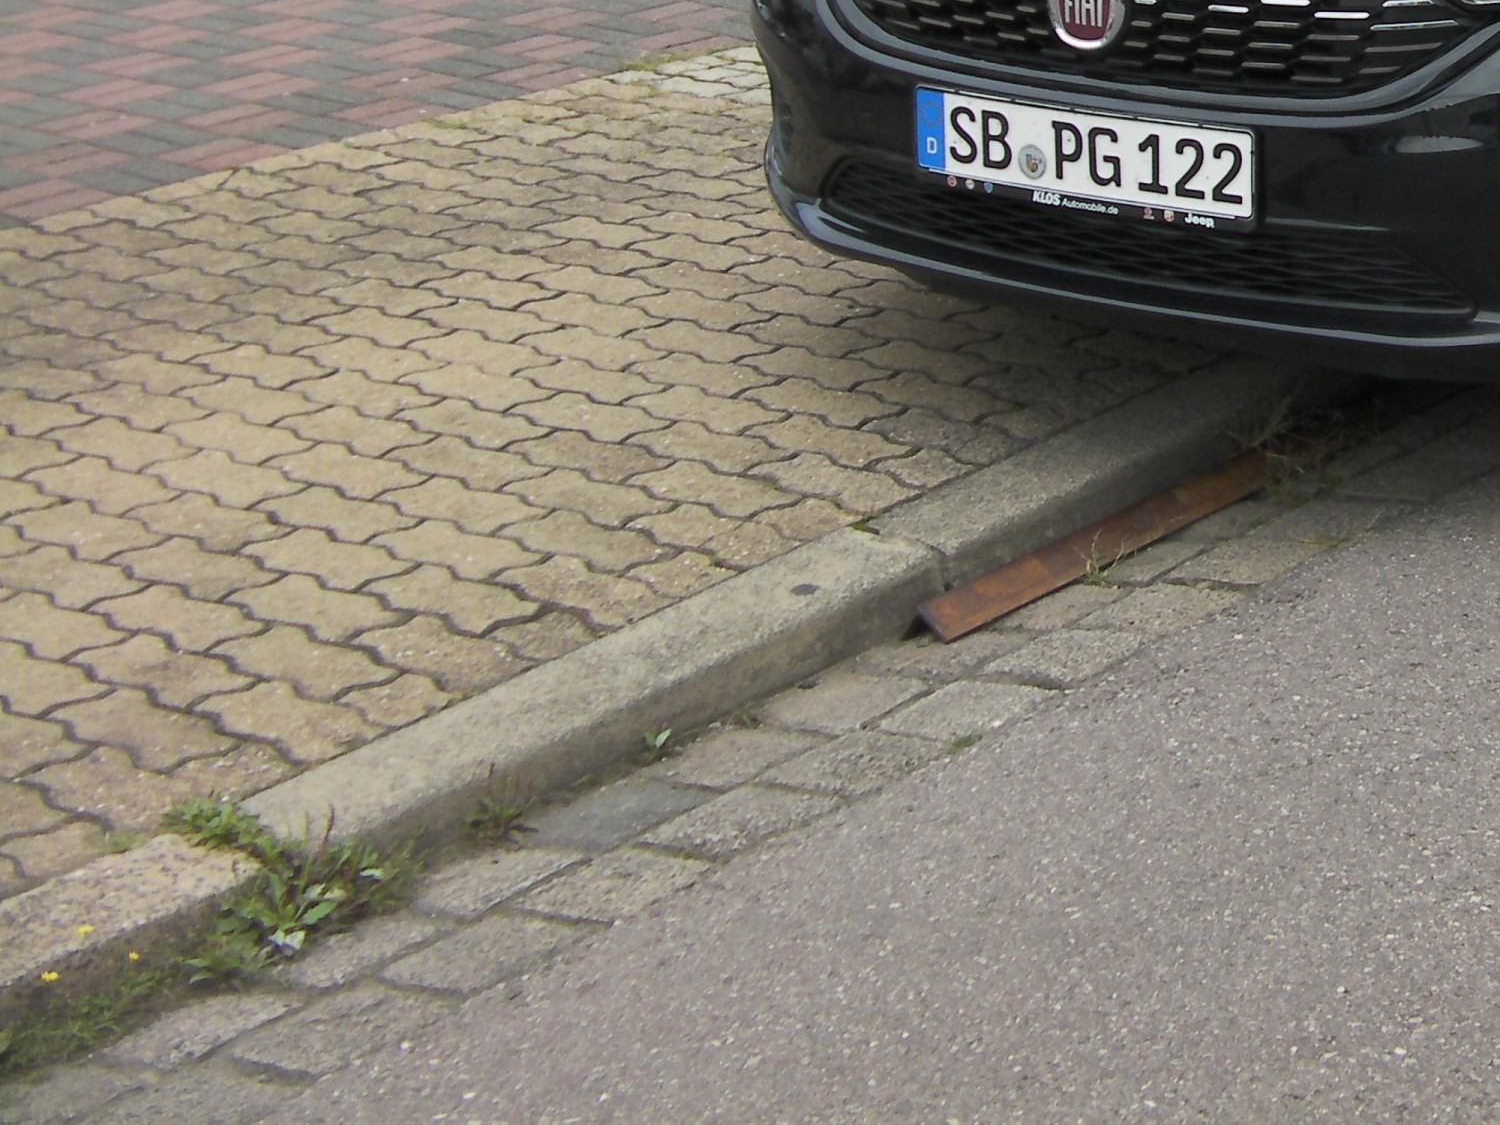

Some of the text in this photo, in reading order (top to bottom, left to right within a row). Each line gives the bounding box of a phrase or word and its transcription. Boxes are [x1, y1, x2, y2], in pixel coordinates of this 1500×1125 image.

[926, 136, 938, 154] D
[949, 105, 1243, 205] SB PG 122
[1032, 190, 1119, 217] KLOS Automobile.de
[1184, 212, 1216, 229] Jeep
